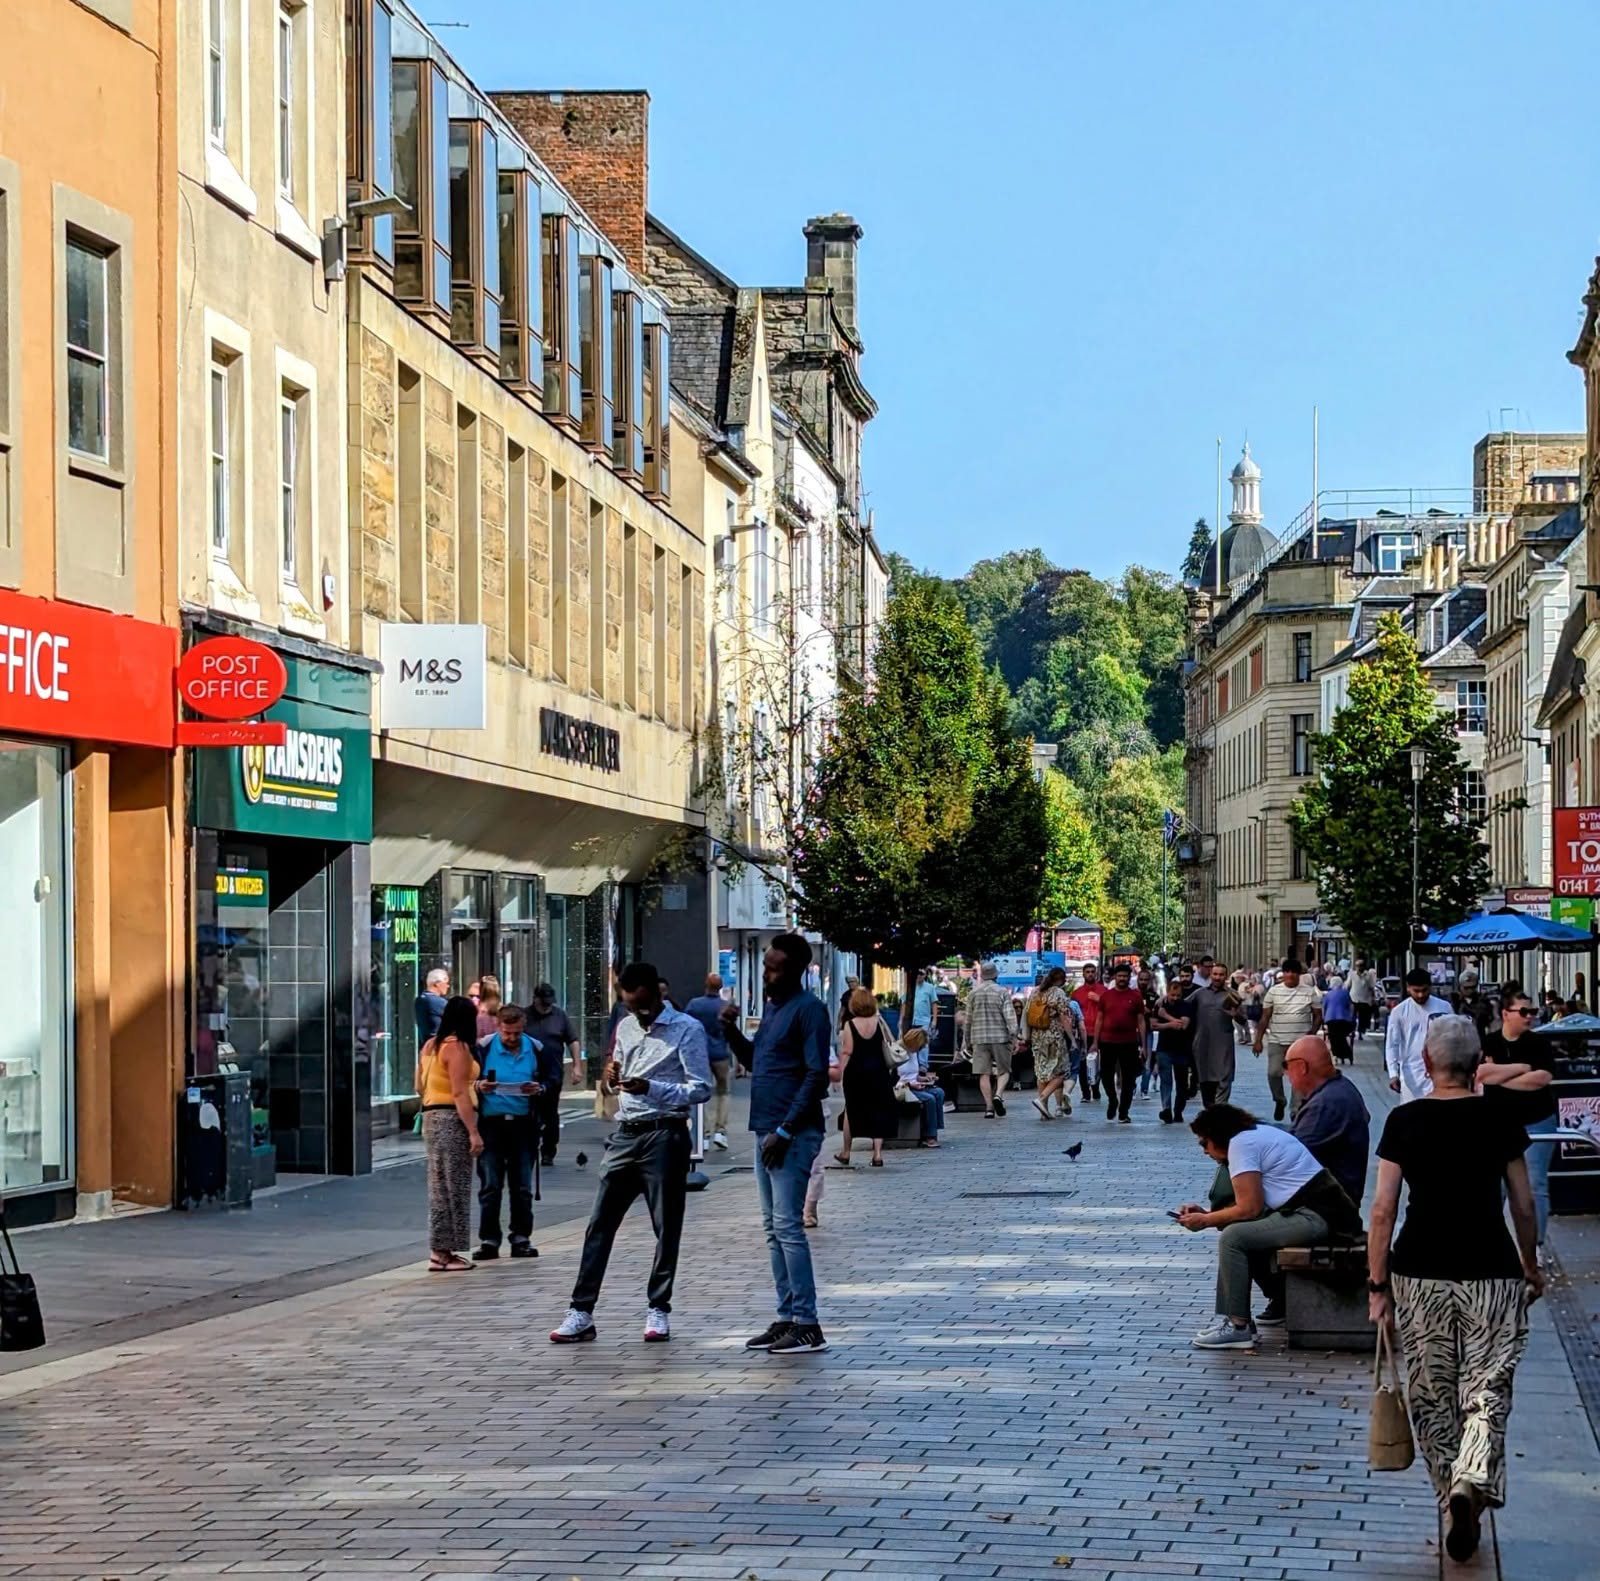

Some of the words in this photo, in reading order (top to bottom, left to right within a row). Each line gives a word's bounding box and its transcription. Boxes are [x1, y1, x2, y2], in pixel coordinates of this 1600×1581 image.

[203, 655, 261, 675] POST
[399, 658, 462, 684] M&S
[187, 679, 270, 699] OFFICE
[264, 729, 343, 786] RAMSDENS
[1567, 840, 1600, 863] TO
[1559, 879, 1589, 894] 0141
[385, 889, 418, 911] AUTUMN
[1456, 931, 1509, 940] NERO
[1480, 944, 1505, 952] COFFEE
